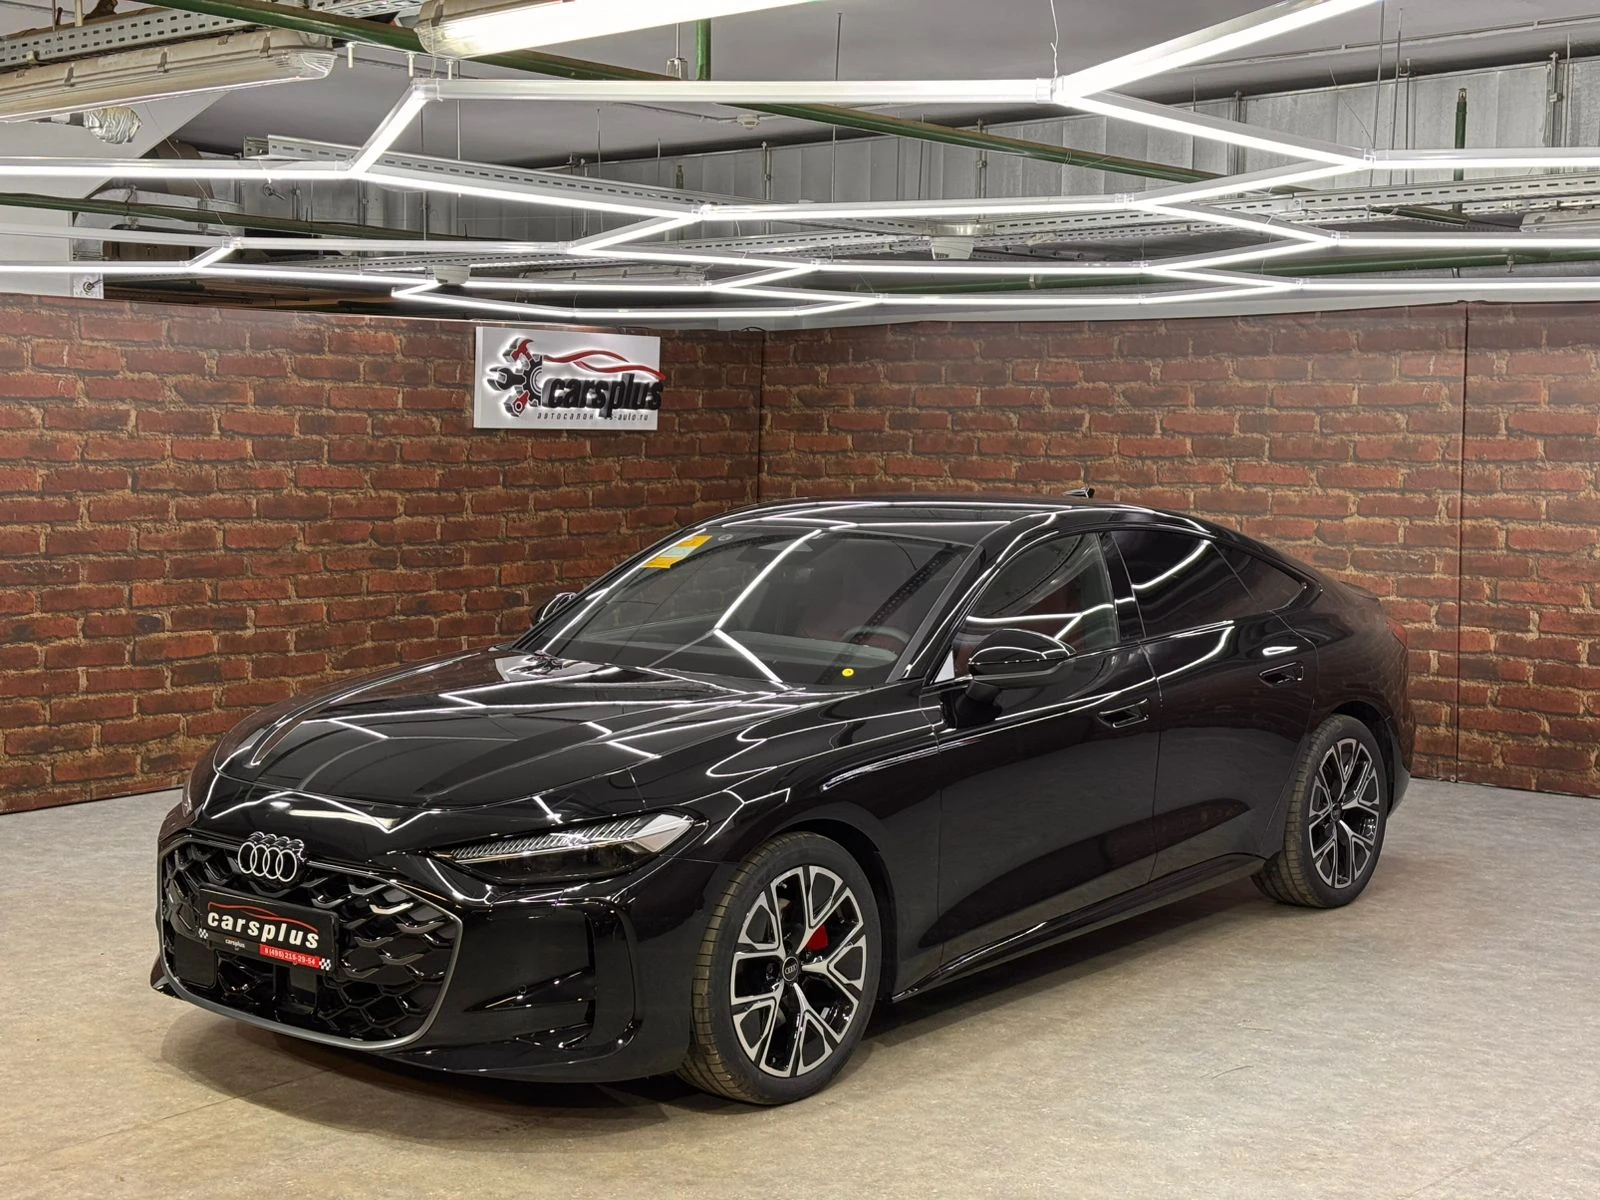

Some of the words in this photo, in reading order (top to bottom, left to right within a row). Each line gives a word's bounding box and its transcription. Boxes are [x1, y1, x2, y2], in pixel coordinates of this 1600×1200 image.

[543, 373, 664, 417] carsplus
[537, 412, 594, 420] автосалон
[208, 912, 319, 949] carsplus
